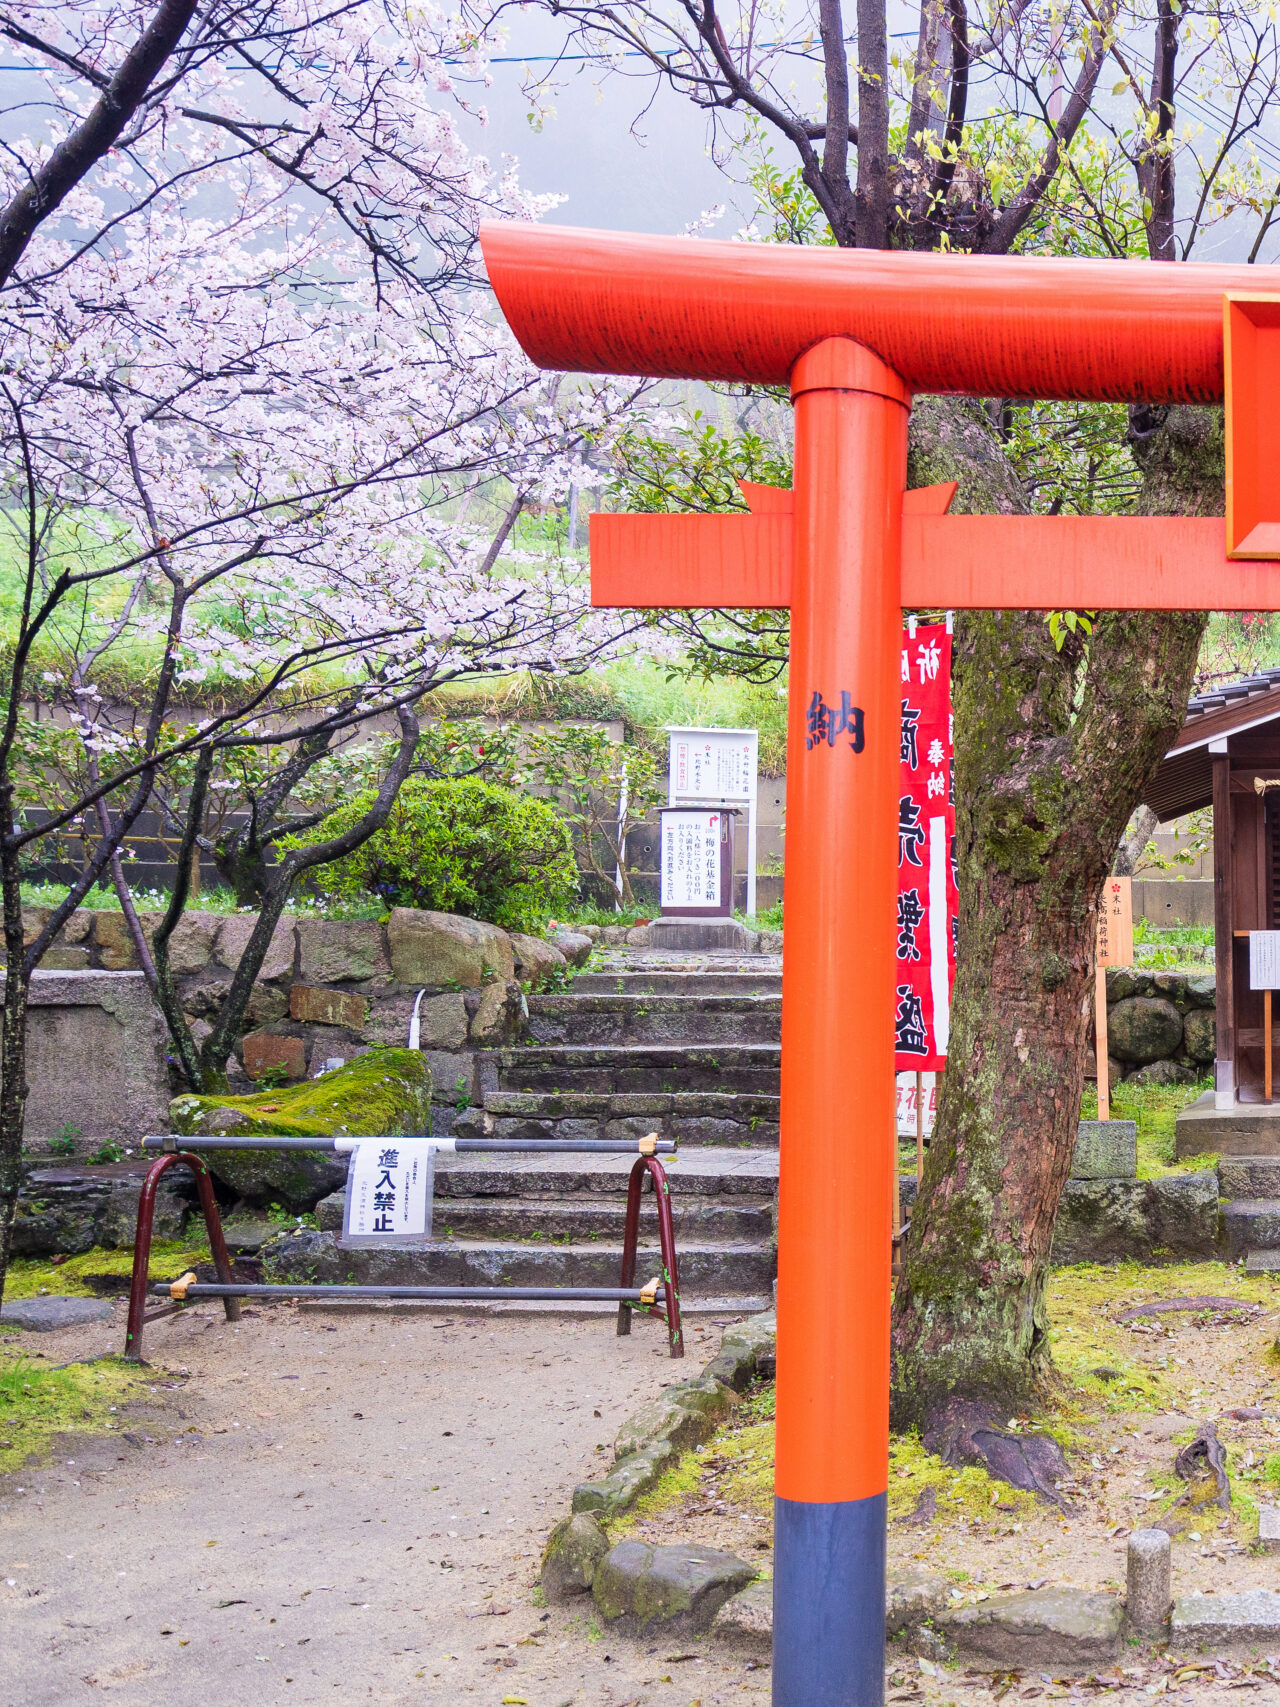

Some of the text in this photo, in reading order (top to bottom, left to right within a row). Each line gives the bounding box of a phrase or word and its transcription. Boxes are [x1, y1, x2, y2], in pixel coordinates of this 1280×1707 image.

[804, 690, 865, 753] 納
[705, 837, 715, 901] 梅の花基金箱
[372, 1148, 400, 1232] 進入禁止
